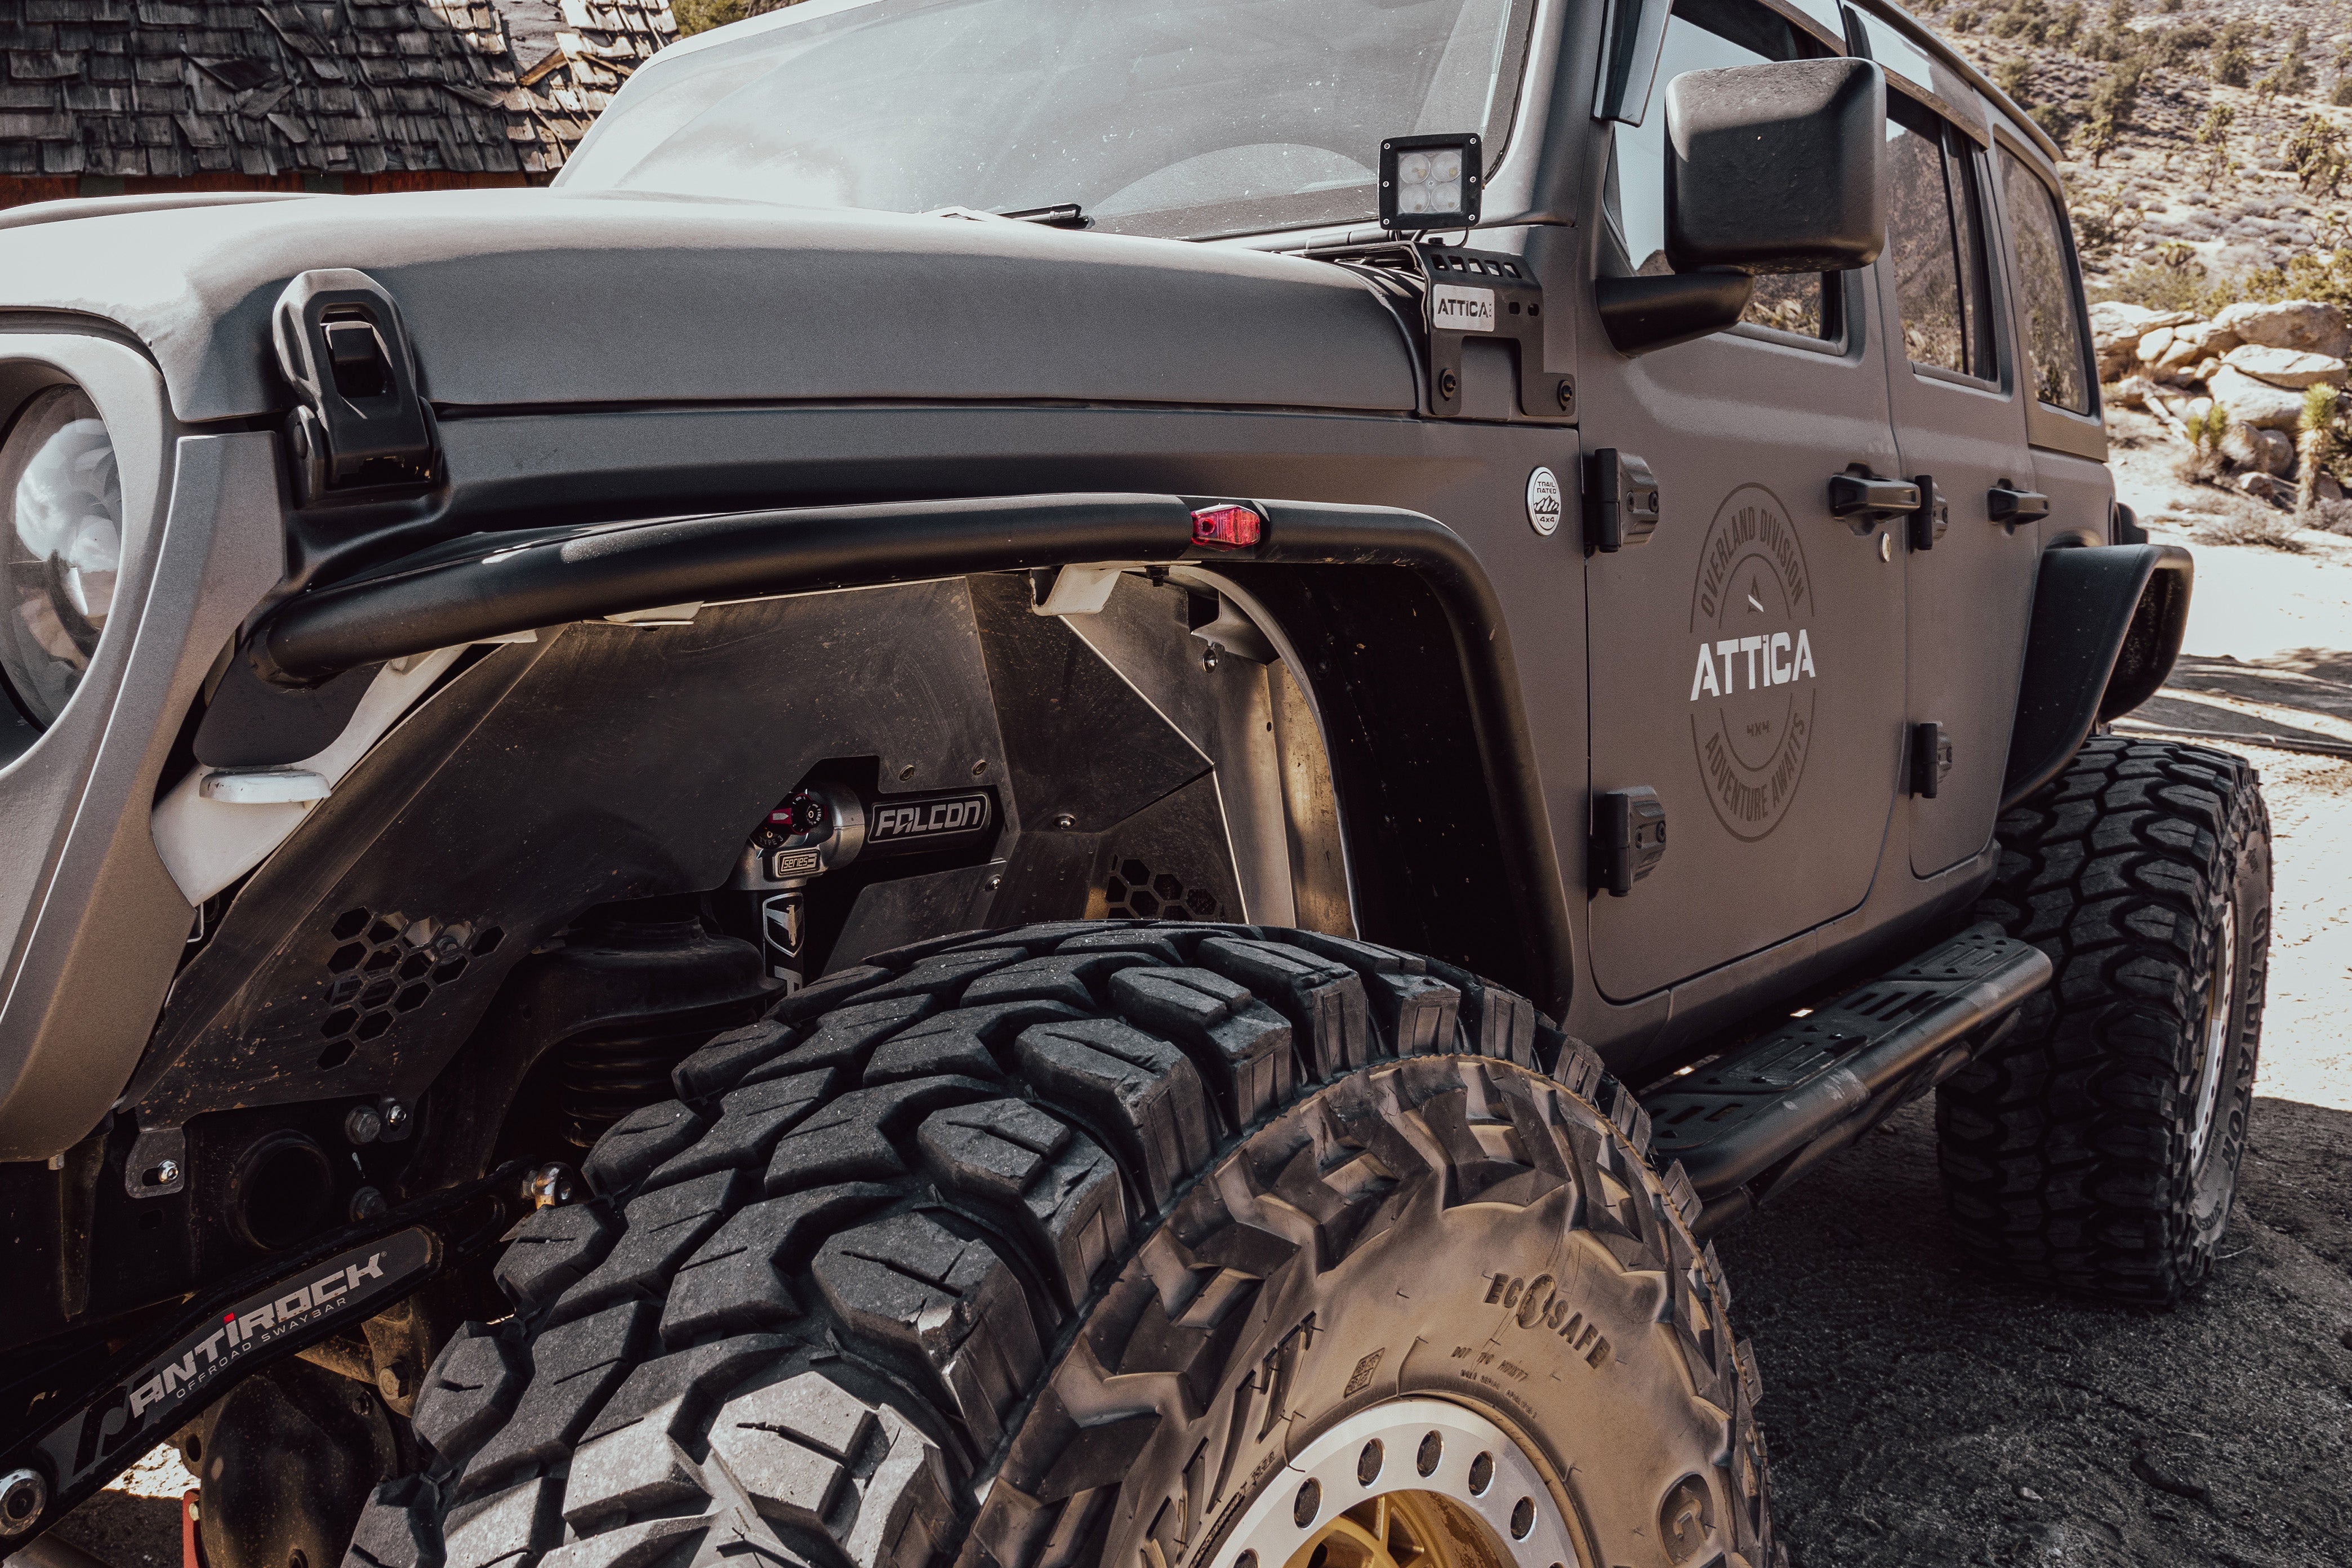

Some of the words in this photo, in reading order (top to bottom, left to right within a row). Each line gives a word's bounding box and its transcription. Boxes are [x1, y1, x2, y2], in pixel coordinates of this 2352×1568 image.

[1701, 506, 1756, 618] OVERLAND
[1759, 507, 1804, 607] DIVISION
[875, 800, 981, 837] FALCON
[1705, 732, 1769, 822] ADVENTURE
[1771, 712, 1805, 809] AWAITS
[759, 836, 777, 845] TYPE
[2221, 907, 2269, 1171] GLADIATOR
[176, 1342, 252, 1398] OFFROAD
[261, 1297, 347, 1343] SWAYBAR
